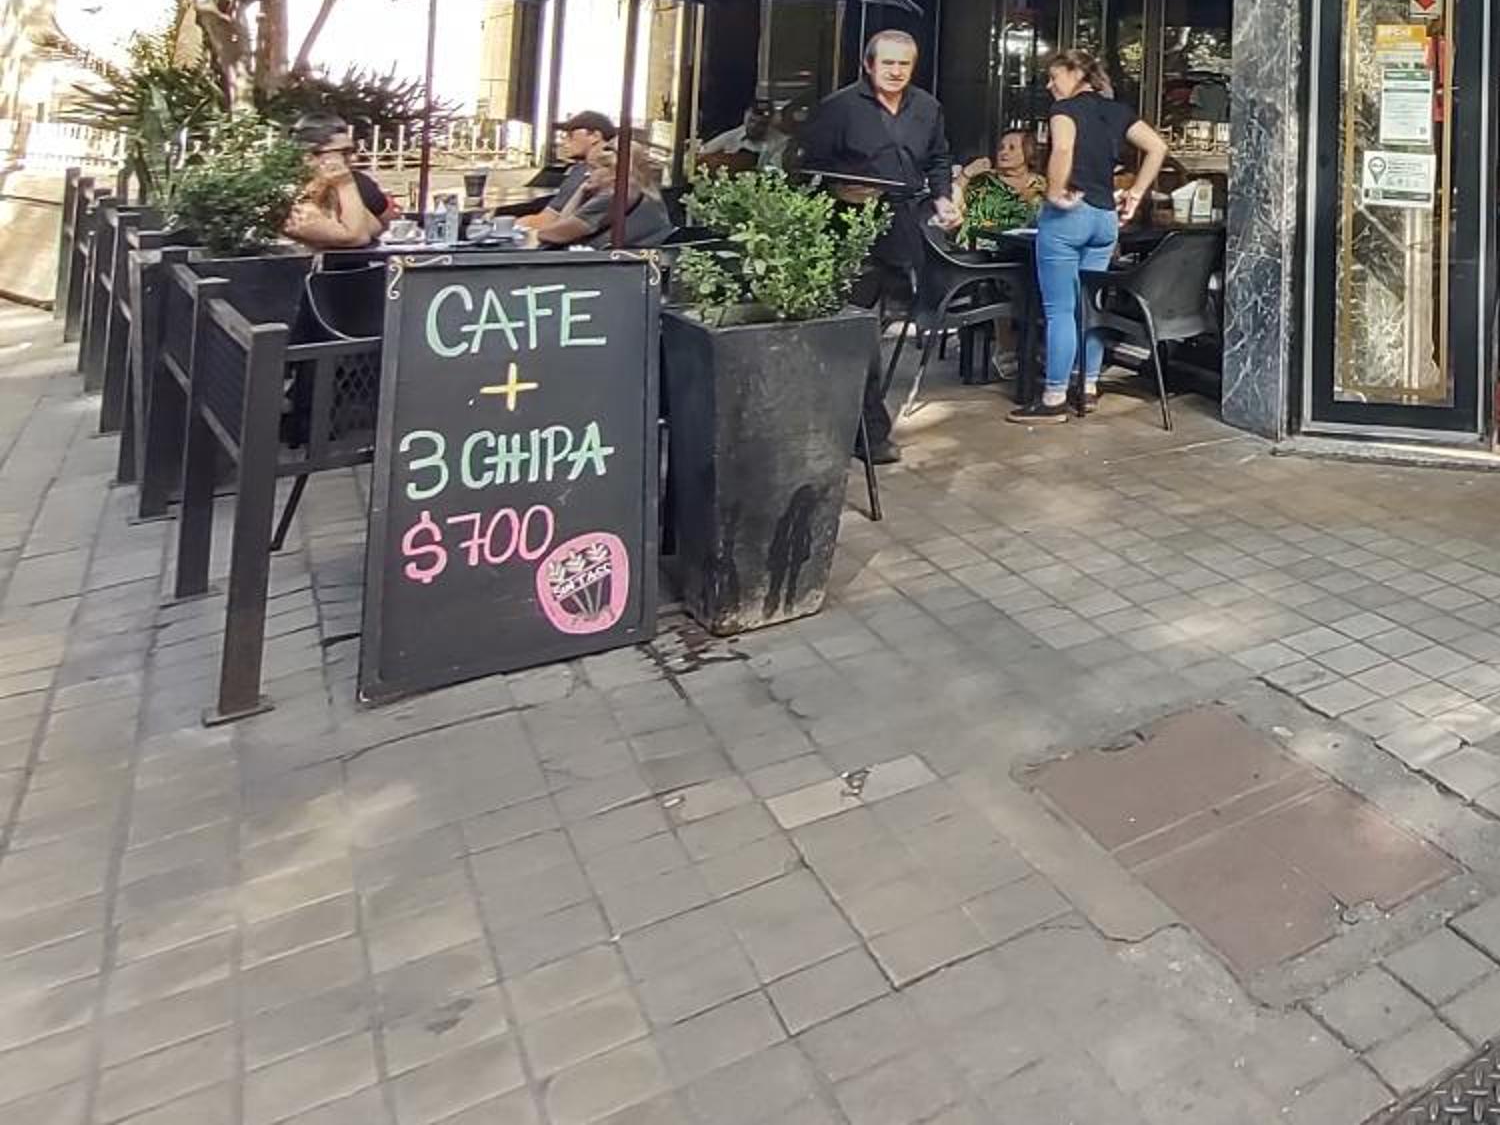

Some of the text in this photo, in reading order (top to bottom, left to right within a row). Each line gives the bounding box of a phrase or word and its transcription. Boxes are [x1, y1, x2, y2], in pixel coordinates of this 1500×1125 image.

[425, 283, 607, 358] CAFE
[399, 421, 616, 500] 3 CHIPA
